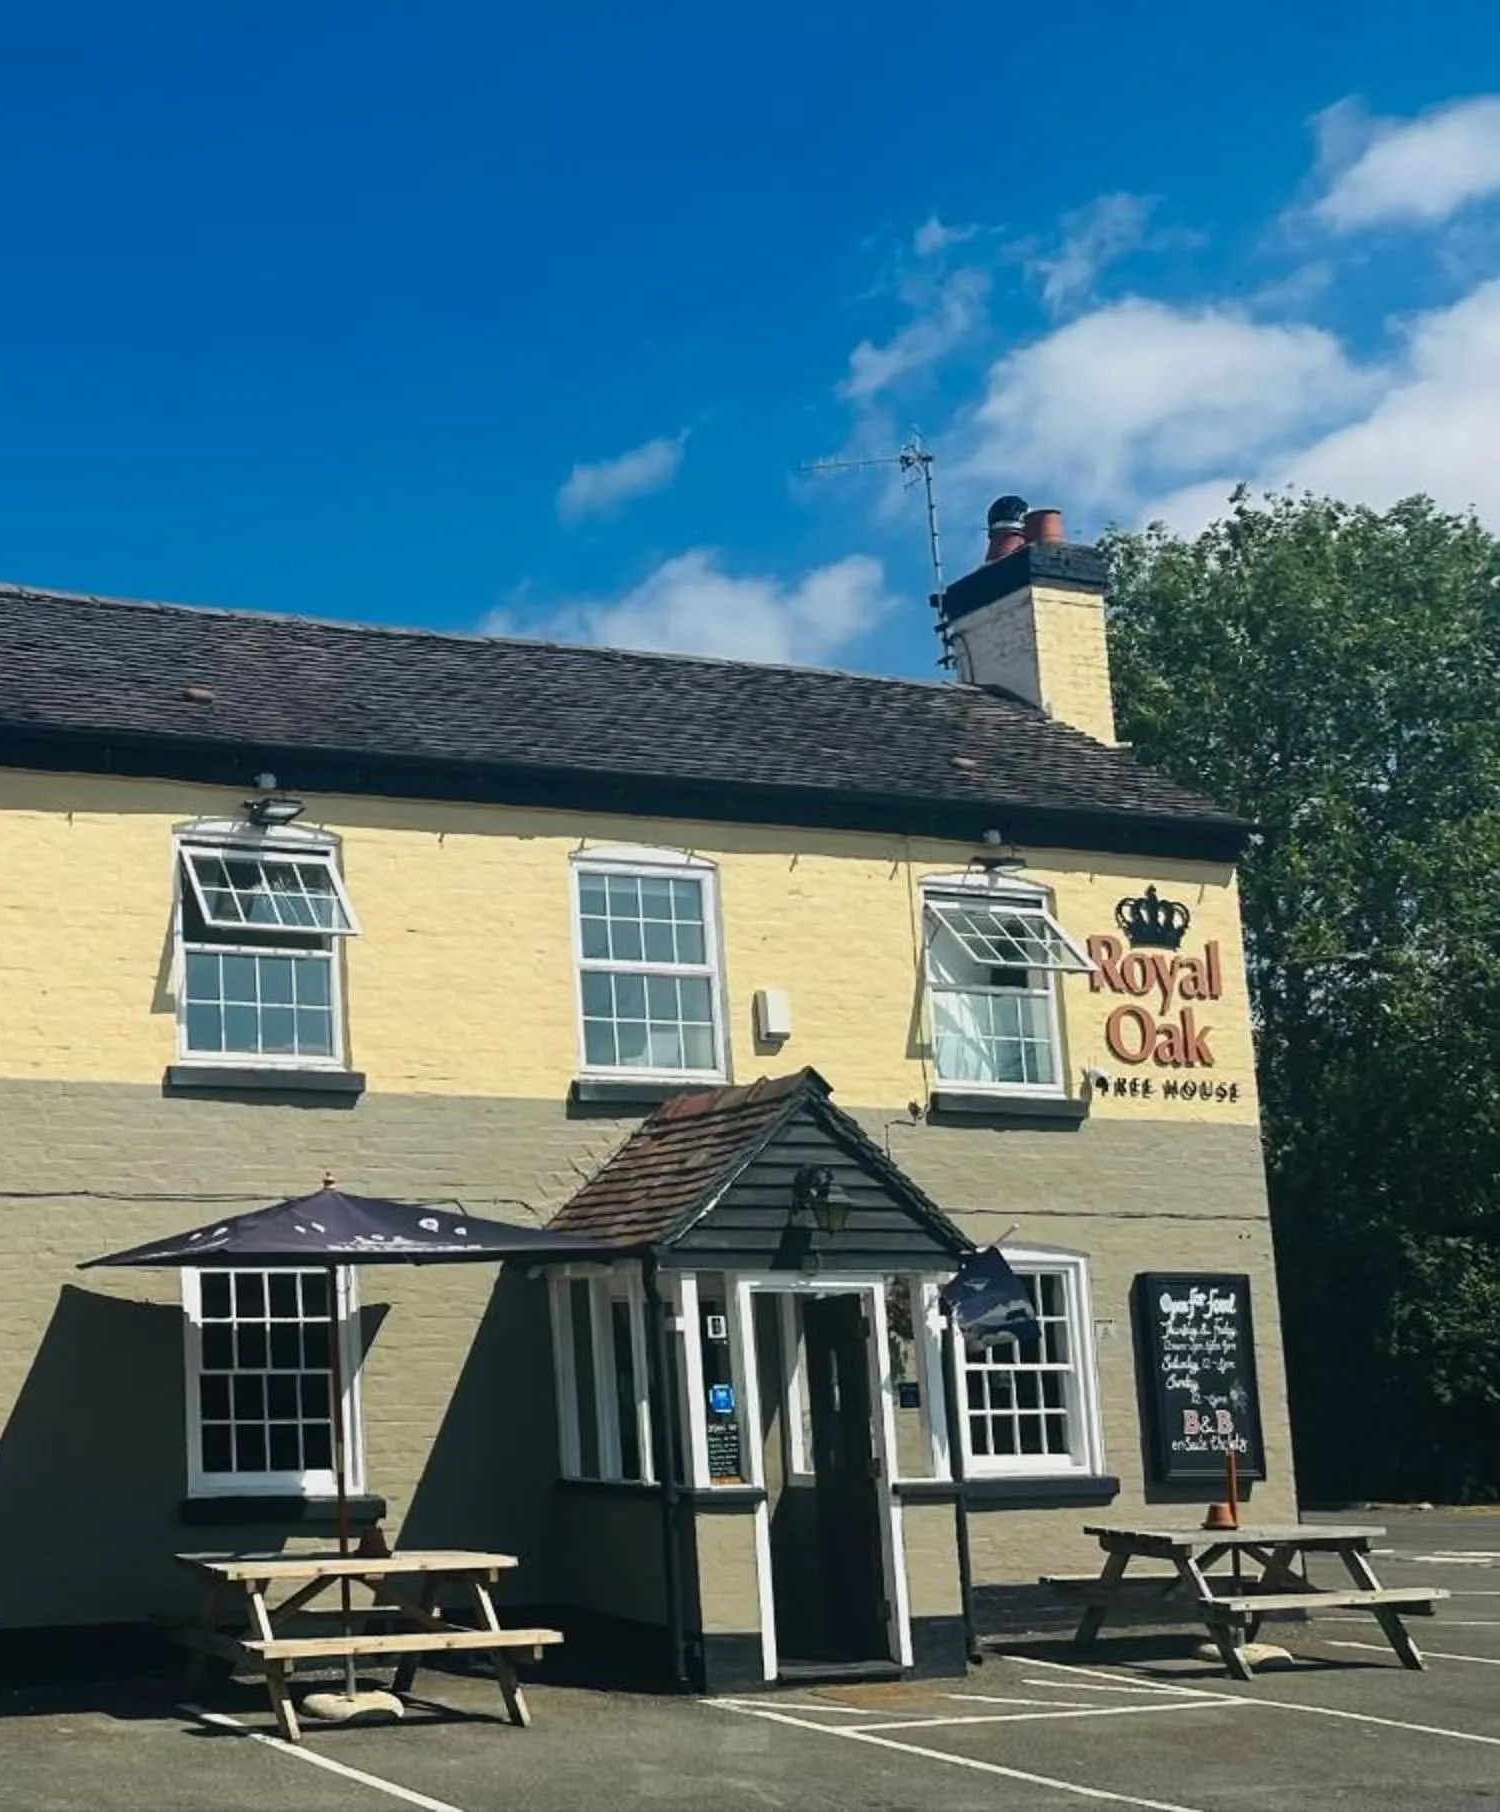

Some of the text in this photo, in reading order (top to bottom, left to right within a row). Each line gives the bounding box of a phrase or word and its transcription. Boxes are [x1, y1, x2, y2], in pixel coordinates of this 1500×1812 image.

[1086, 934, 1222, 1016] Royal
[1105, 1004, 1213, 1069] Oak
[1163, 1079, 1240, 1103] HOUSE
[1159, 1292, 1189, 1322] Open
[1202, 1287, 1237, 1319] food
